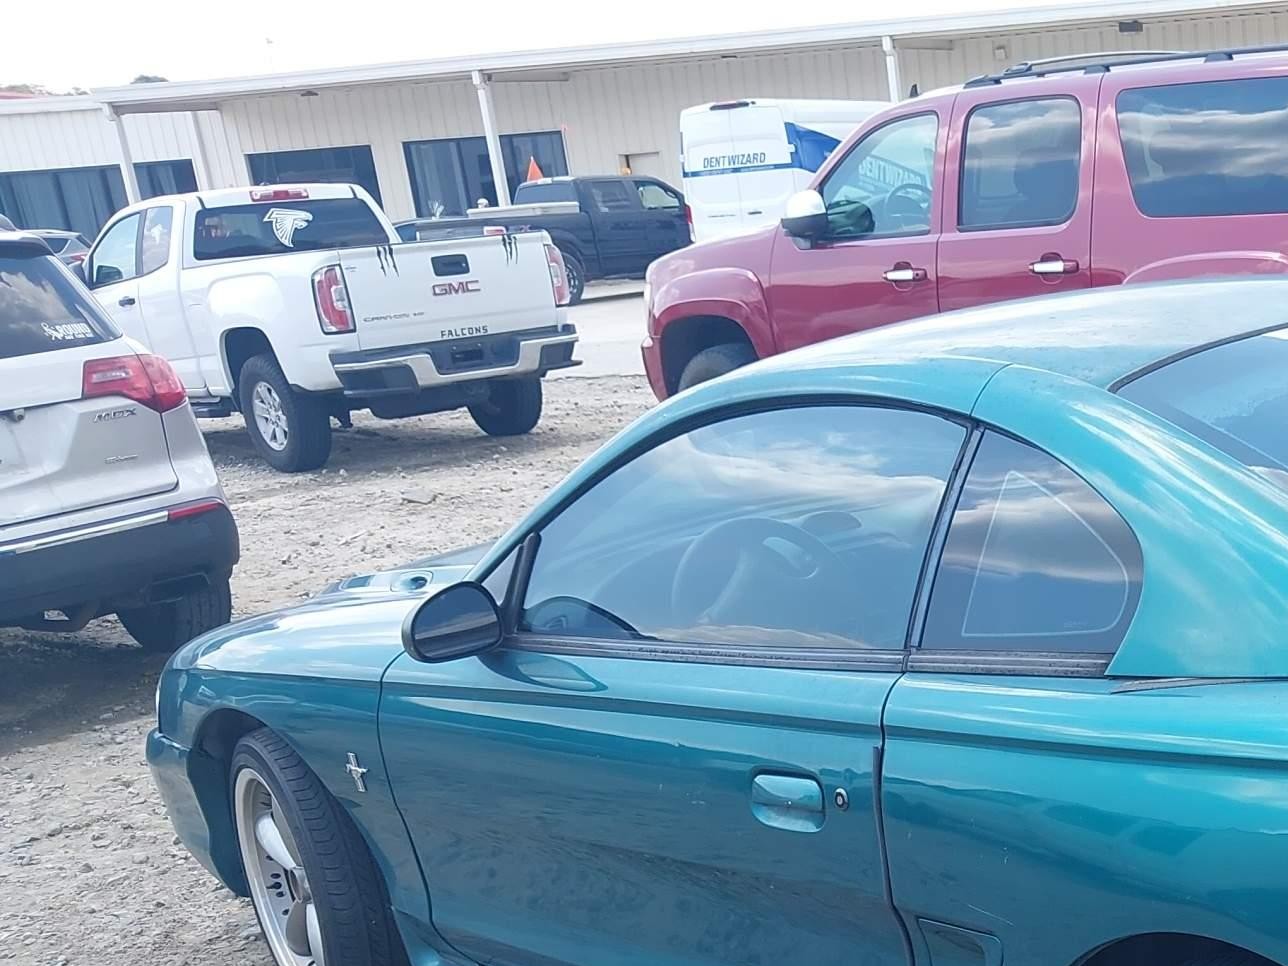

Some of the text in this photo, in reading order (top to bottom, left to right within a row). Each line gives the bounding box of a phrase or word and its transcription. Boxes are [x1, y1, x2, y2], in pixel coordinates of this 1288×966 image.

[432, 280, 481, 297] GMC
[440, 325, 488, 339] FALCONS
[93, 408, 137, 423] MDX
